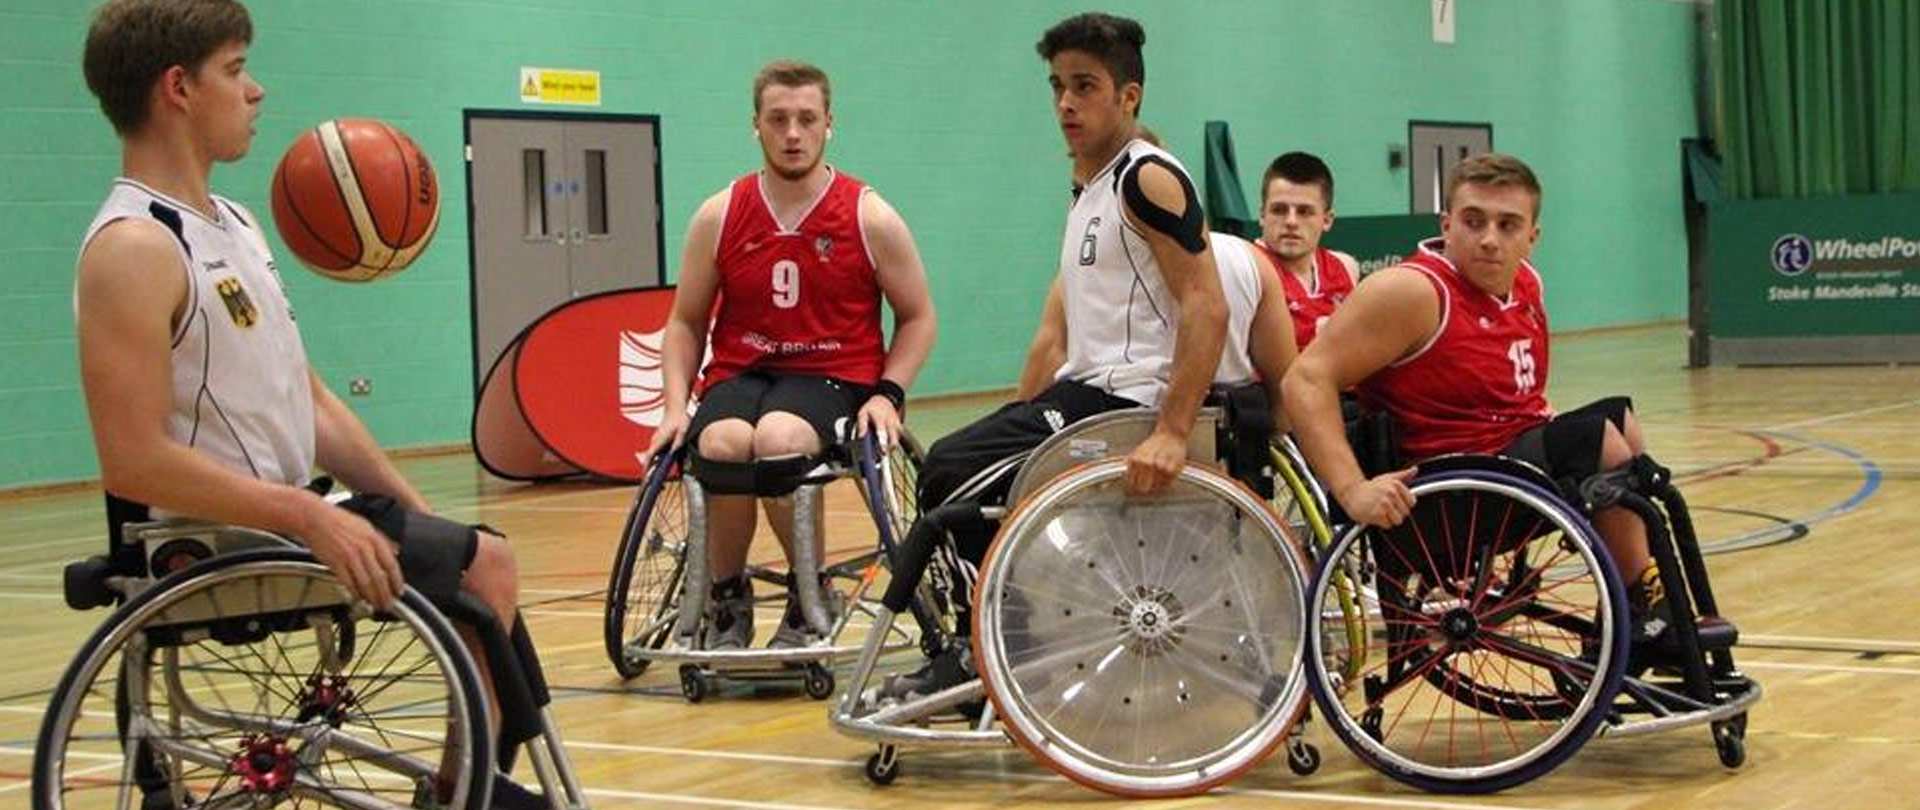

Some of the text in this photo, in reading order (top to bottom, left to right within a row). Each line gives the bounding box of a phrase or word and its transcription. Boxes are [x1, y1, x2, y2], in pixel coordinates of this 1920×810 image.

[1079, 216, 1101, 266] 6
[1814, 236, 1920, 260] WheelPo
[771, 259, 800, 309] 9
[1768, 284, 1810, 300] Stoke
[1813, 282, 1898, 298] Mandeville
[1507, 337, 1536, 395] 15
